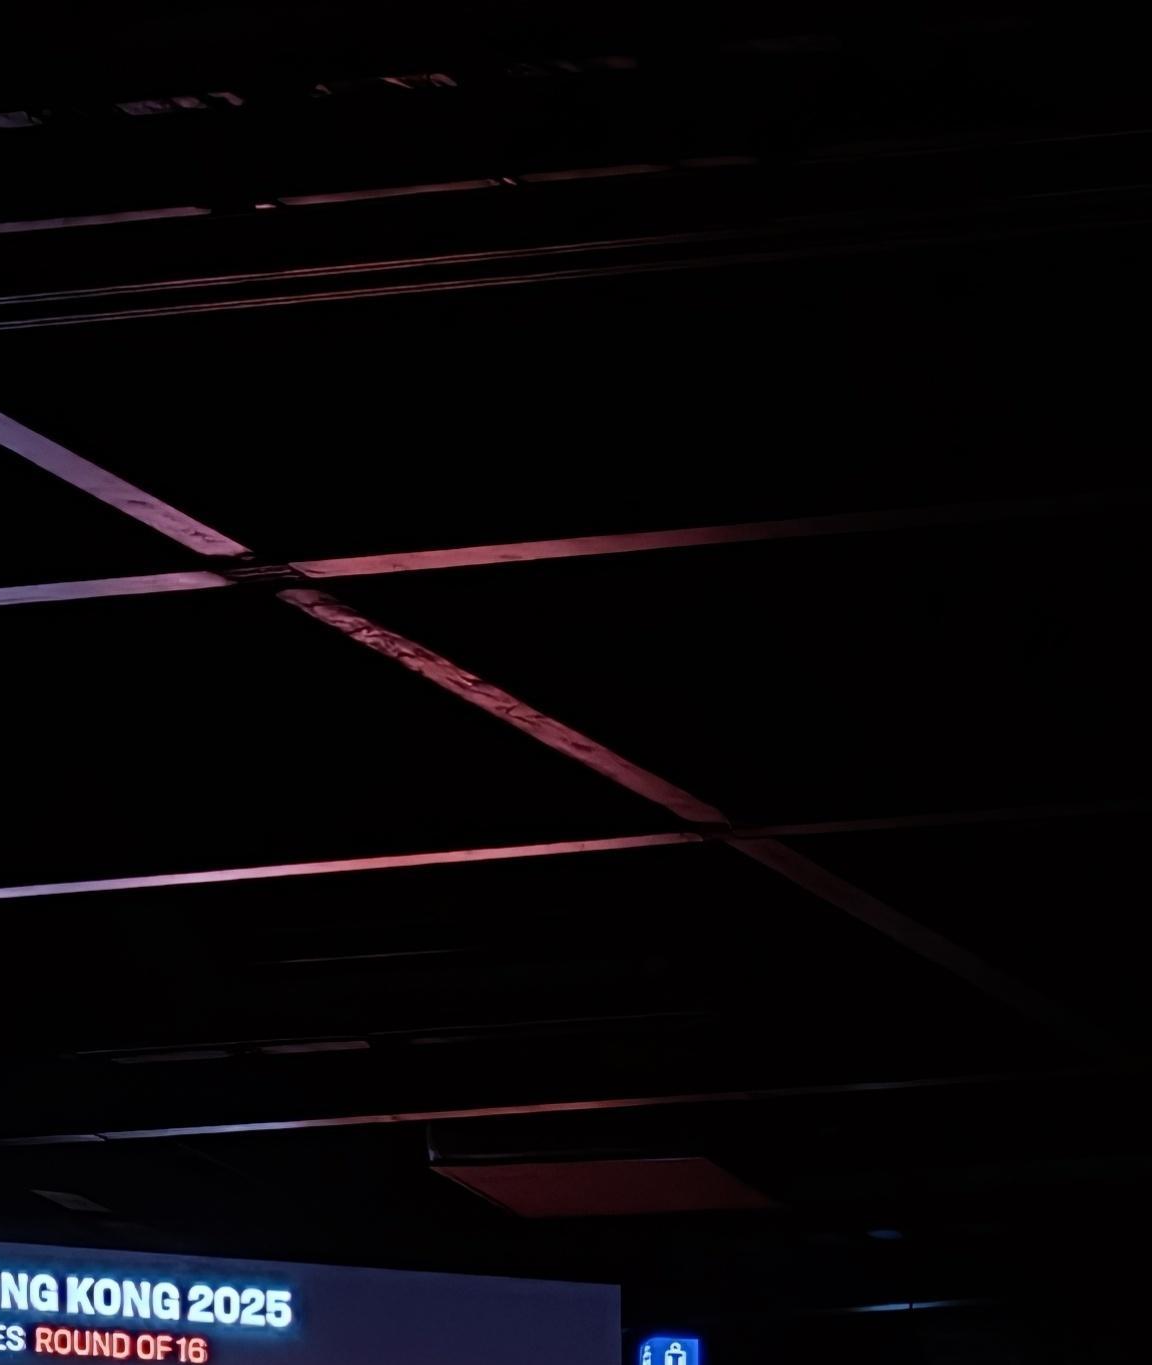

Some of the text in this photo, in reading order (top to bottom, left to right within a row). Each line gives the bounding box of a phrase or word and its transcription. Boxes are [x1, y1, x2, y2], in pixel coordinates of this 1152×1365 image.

[66, 1275, 180, 1320] KONG
[188, 1285, 292, 1327] 2025
[35, 1326, 129, 1360] ROUND
[136, 1333, 171, 1361] OF
[176, 1337, 208, 1364] 16
